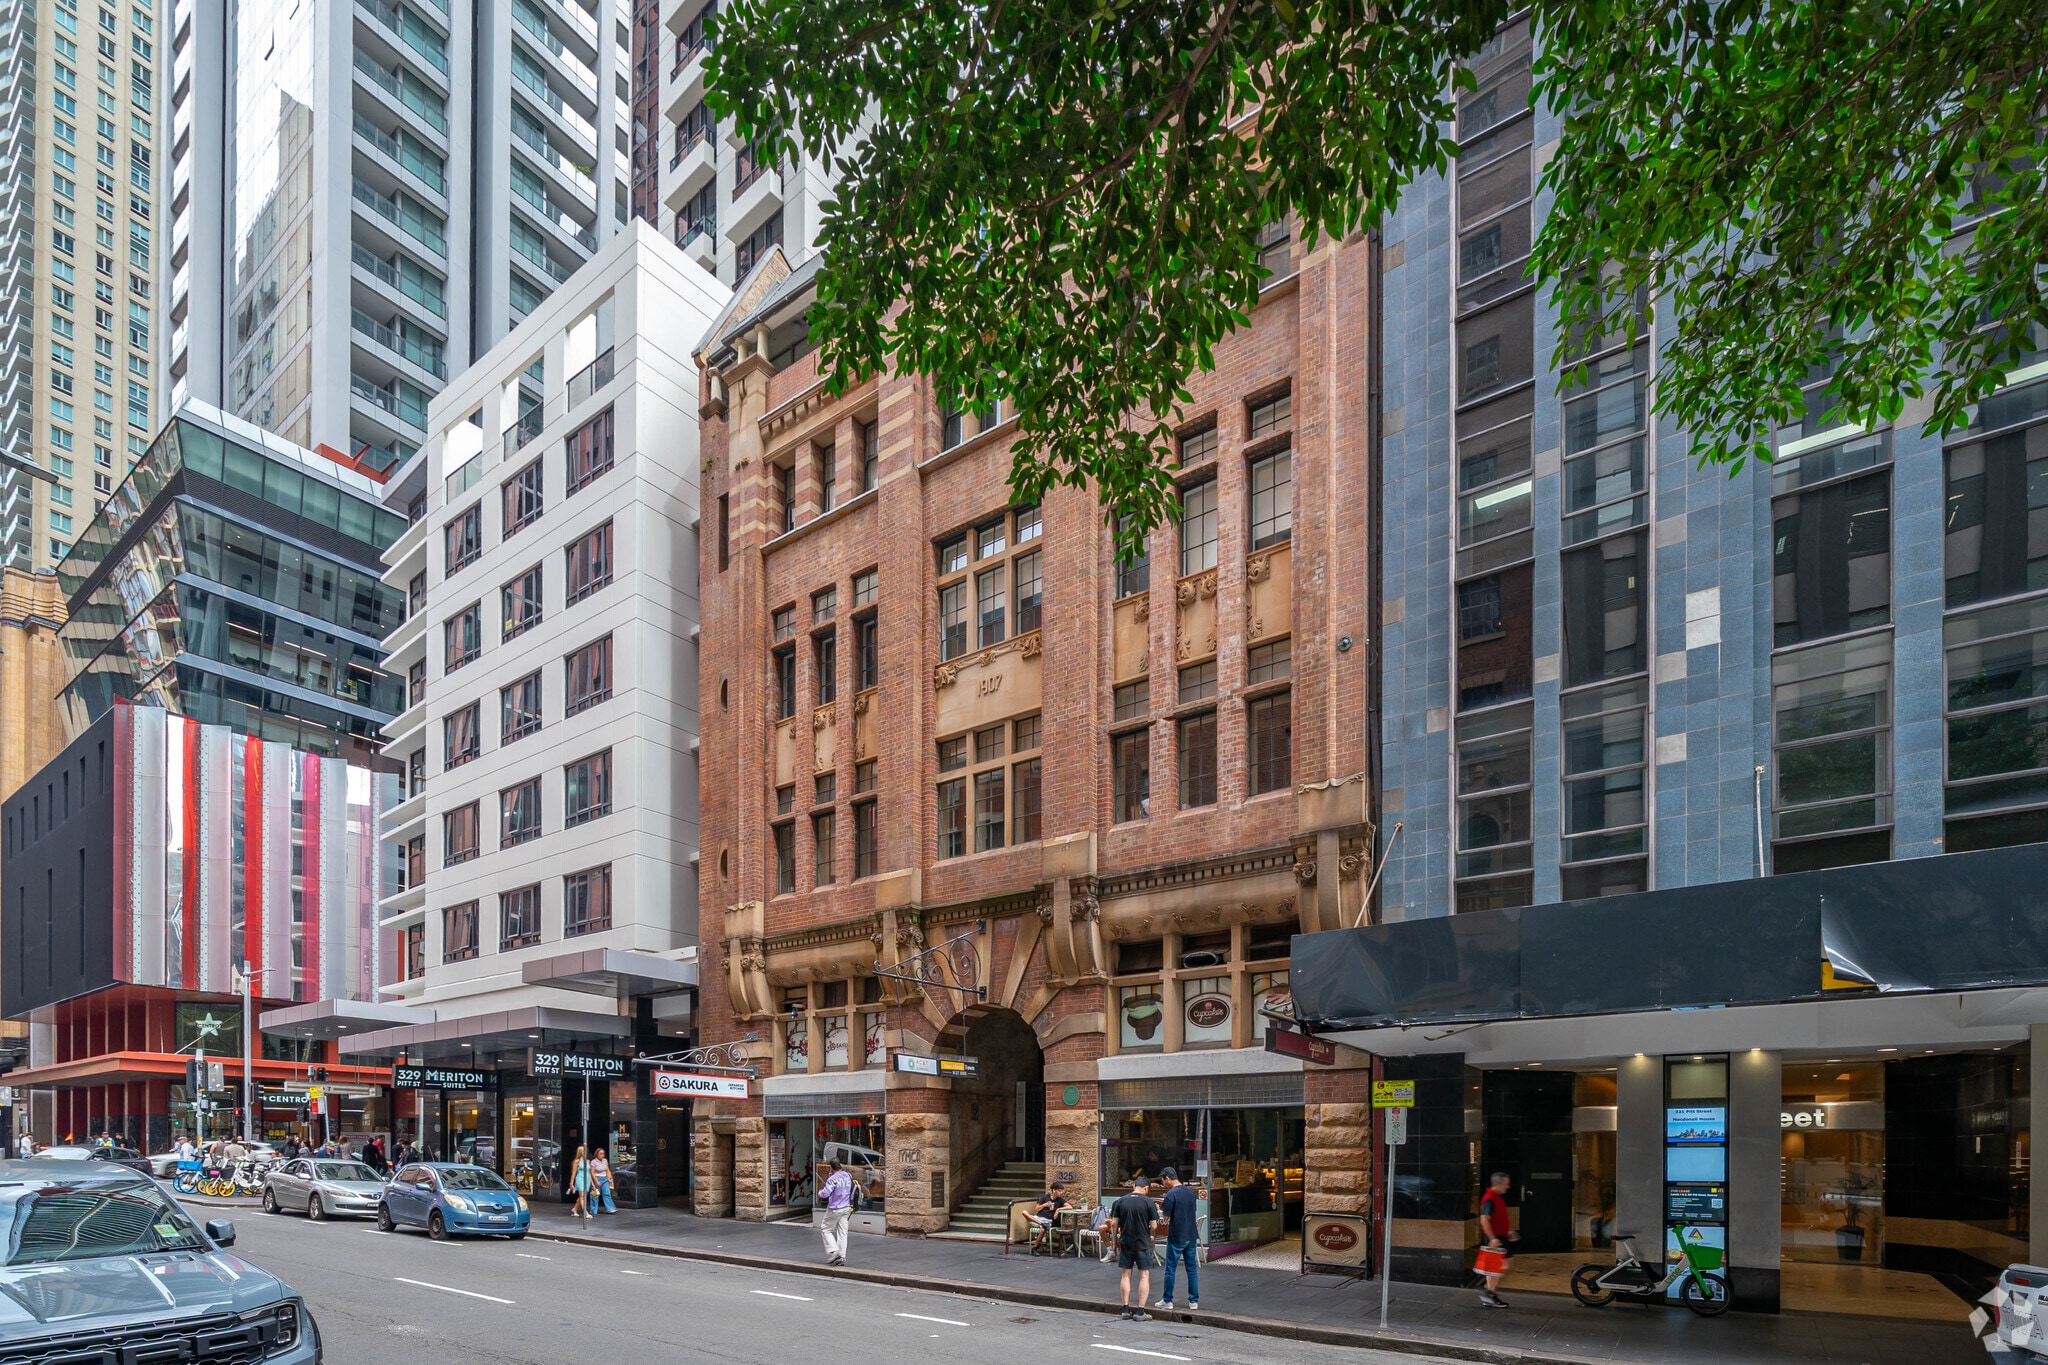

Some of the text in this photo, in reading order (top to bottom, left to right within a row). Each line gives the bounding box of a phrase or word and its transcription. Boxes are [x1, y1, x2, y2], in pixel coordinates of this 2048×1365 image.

[978, 674, 1003, 698] 1907
[535, 1053, 560, 1066] 329
[564, 1053, 624, 1072] MERITON
[397, 1069, 421, 1080] 329
[425, 1069, 483, 1083] MERITON
[535, 1066, 551, 1074] PITT
[582, 1069, 606, 1077] SUITES
[672, 1079, 719, 1092] SAKURA
[268, 1095, 308, 1103] CENTRO
[1780, 1108, 1825, 1128] eet
[1052, 1150, 1081, 1165] YMCA
[903, 1168, 915, 1177] 325
[1058, 1171, 1074, 1181] 325
